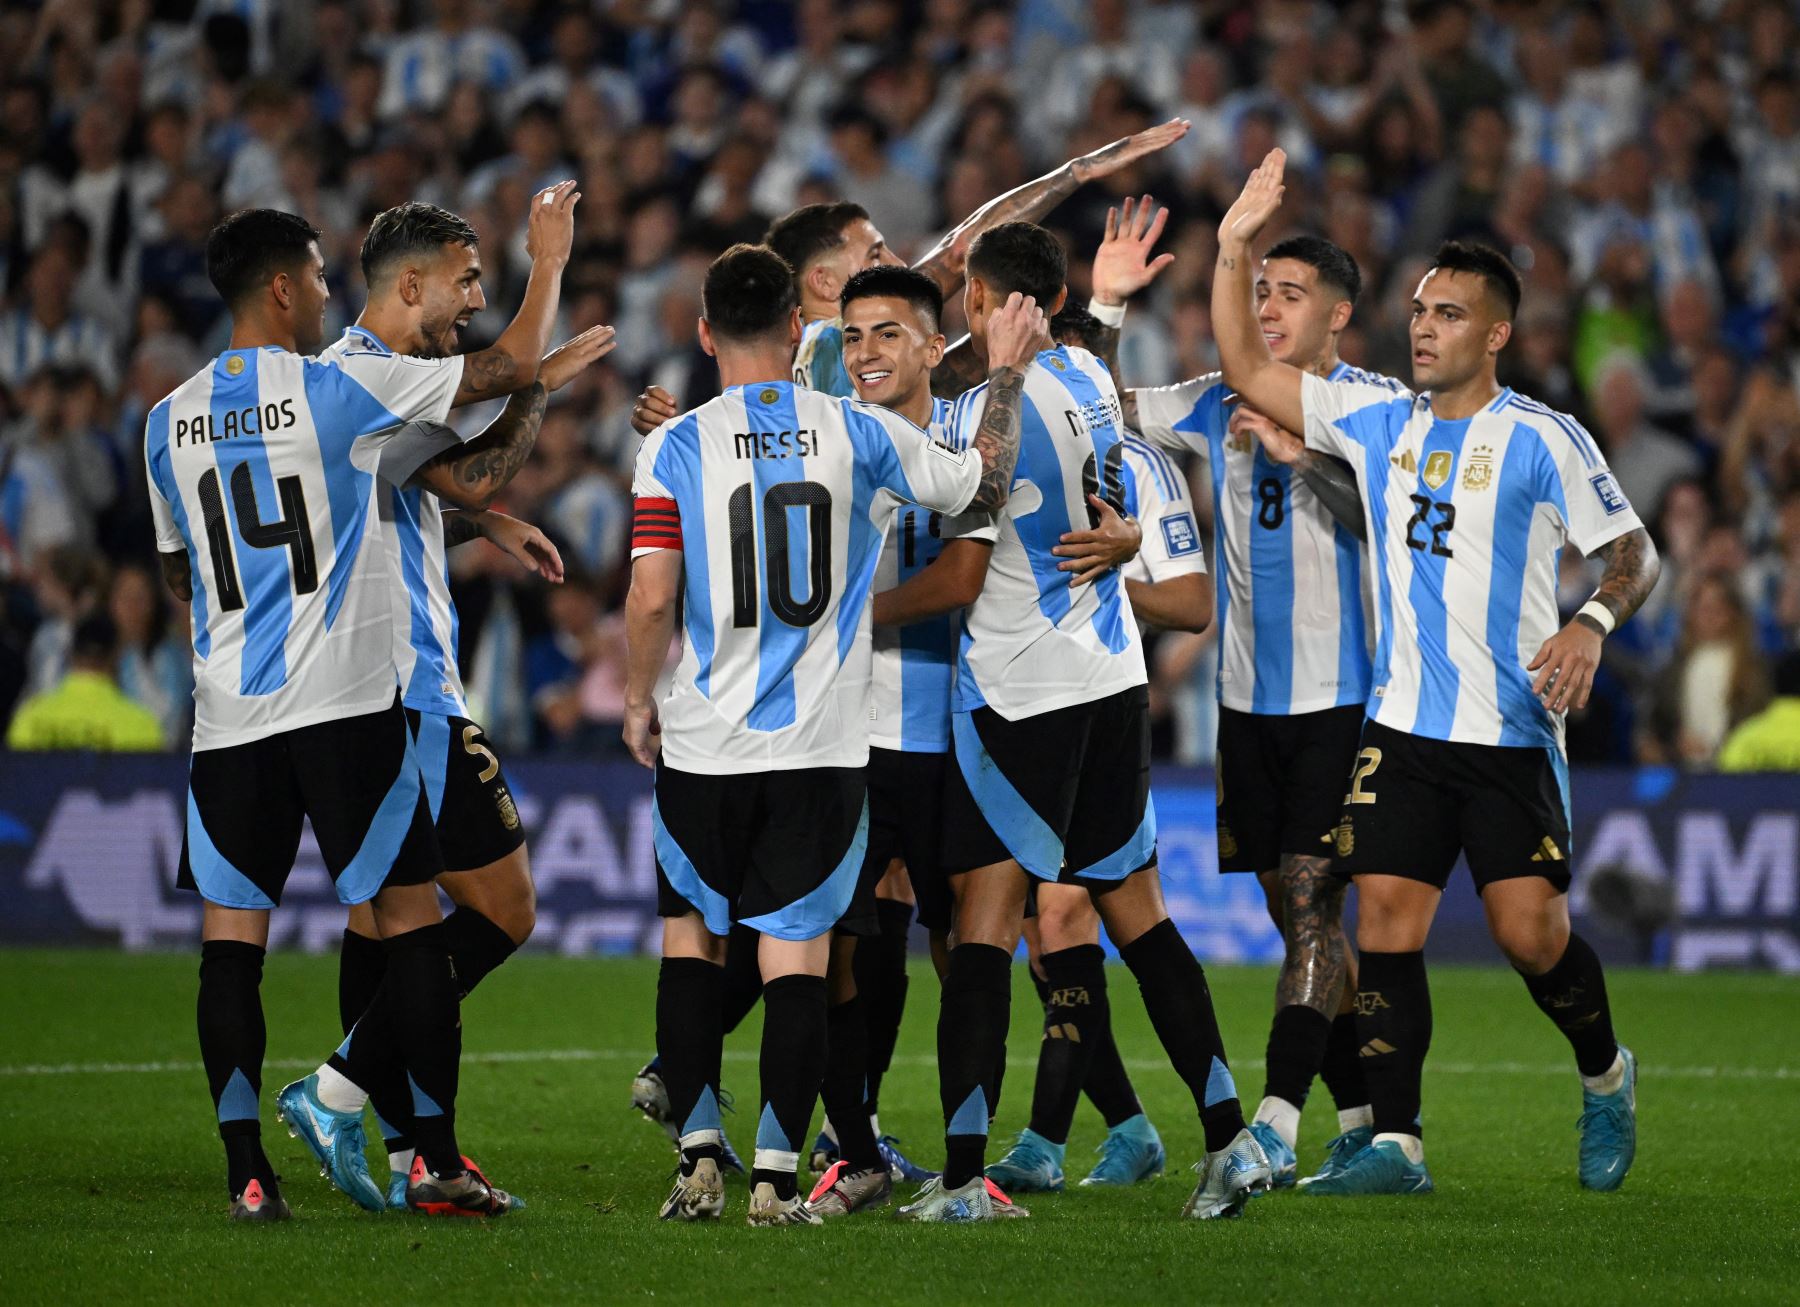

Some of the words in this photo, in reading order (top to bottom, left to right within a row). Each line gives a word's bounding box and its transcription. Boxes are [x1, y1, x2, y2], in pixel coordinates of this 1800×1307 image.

[176, 398, 296, 448] PALACIOS
[734, 429, 819, 459] MESSI
[1258, 478, 1284, 531] 8
[1406, 493, 1456, 558] 22
[197, 460, 319, 613] 14
[728, 480, 833, 629] 10
[462, 725, 499, 783] 5
